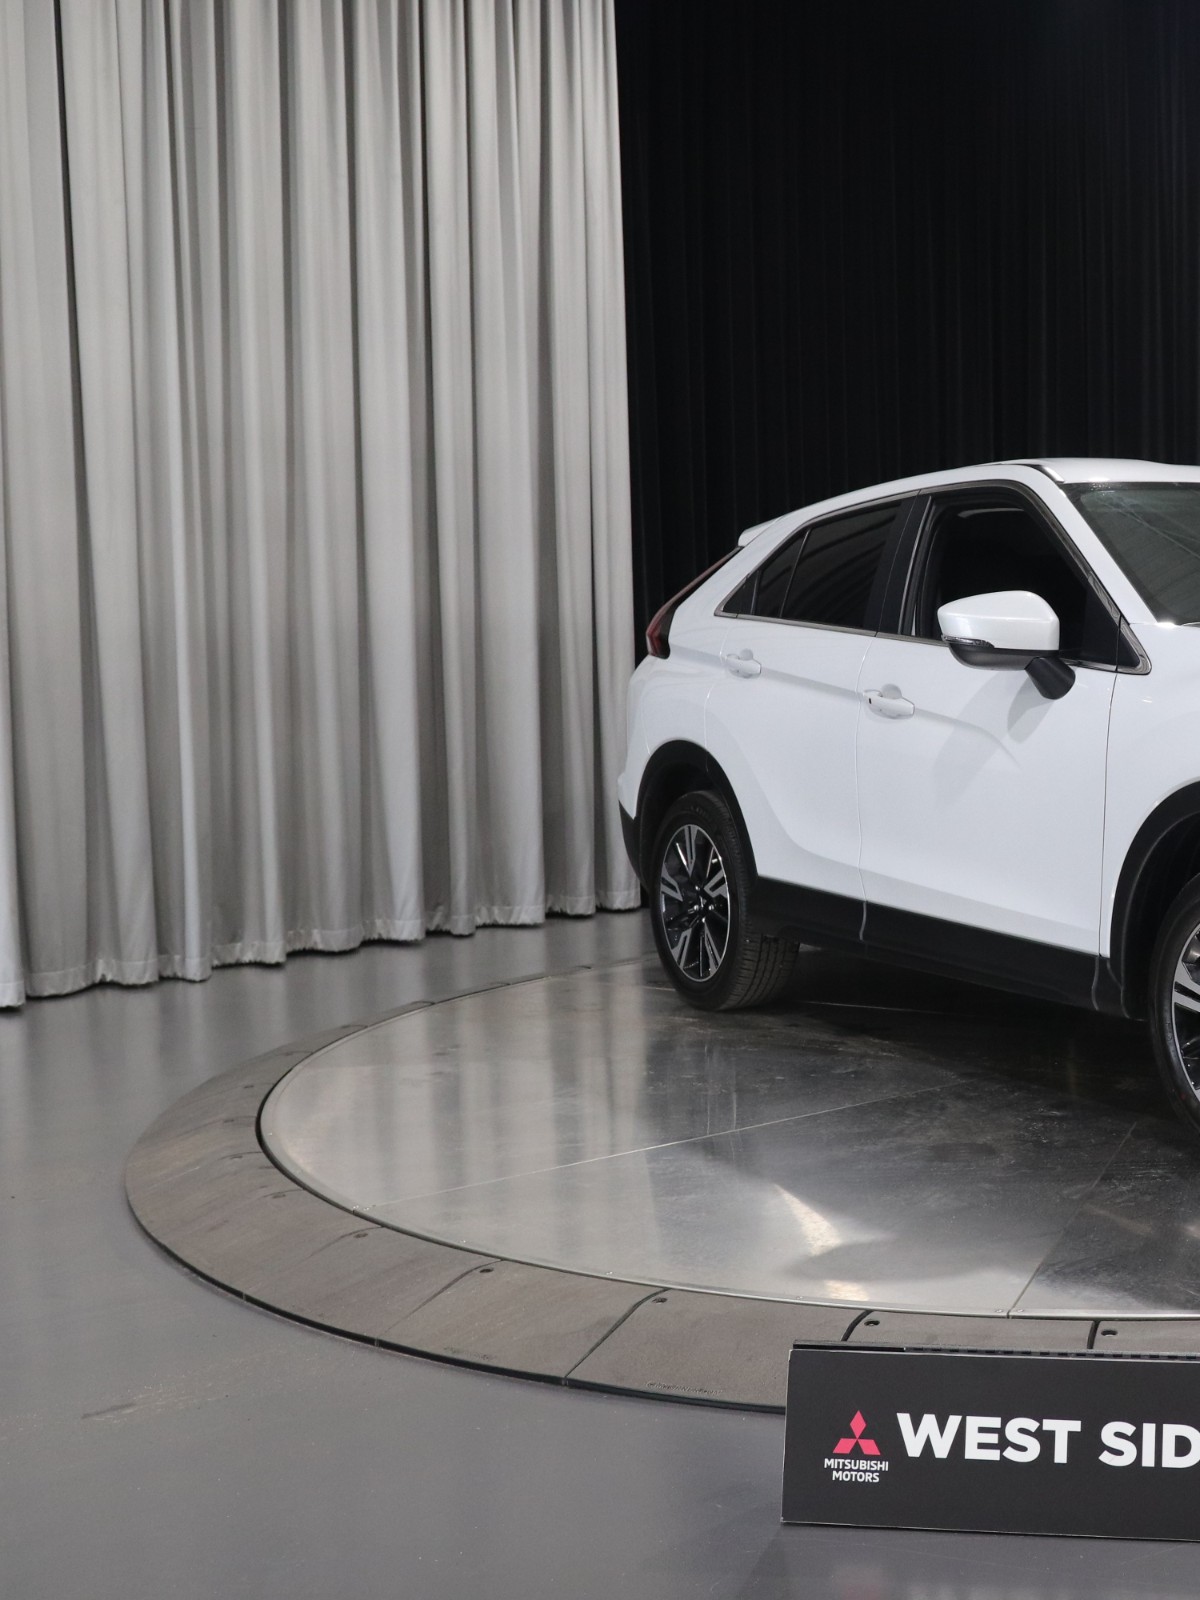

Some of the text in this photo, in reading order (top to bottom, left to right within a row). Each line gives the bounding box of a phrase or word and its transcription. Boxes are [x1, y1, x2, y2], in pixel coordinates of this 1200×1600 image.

[896, 1412, 1082, 1464] WEST
[823, 1457, 889, 1472] MITSUBISHI
[832, 1470, 880, 1483] MOTORS
